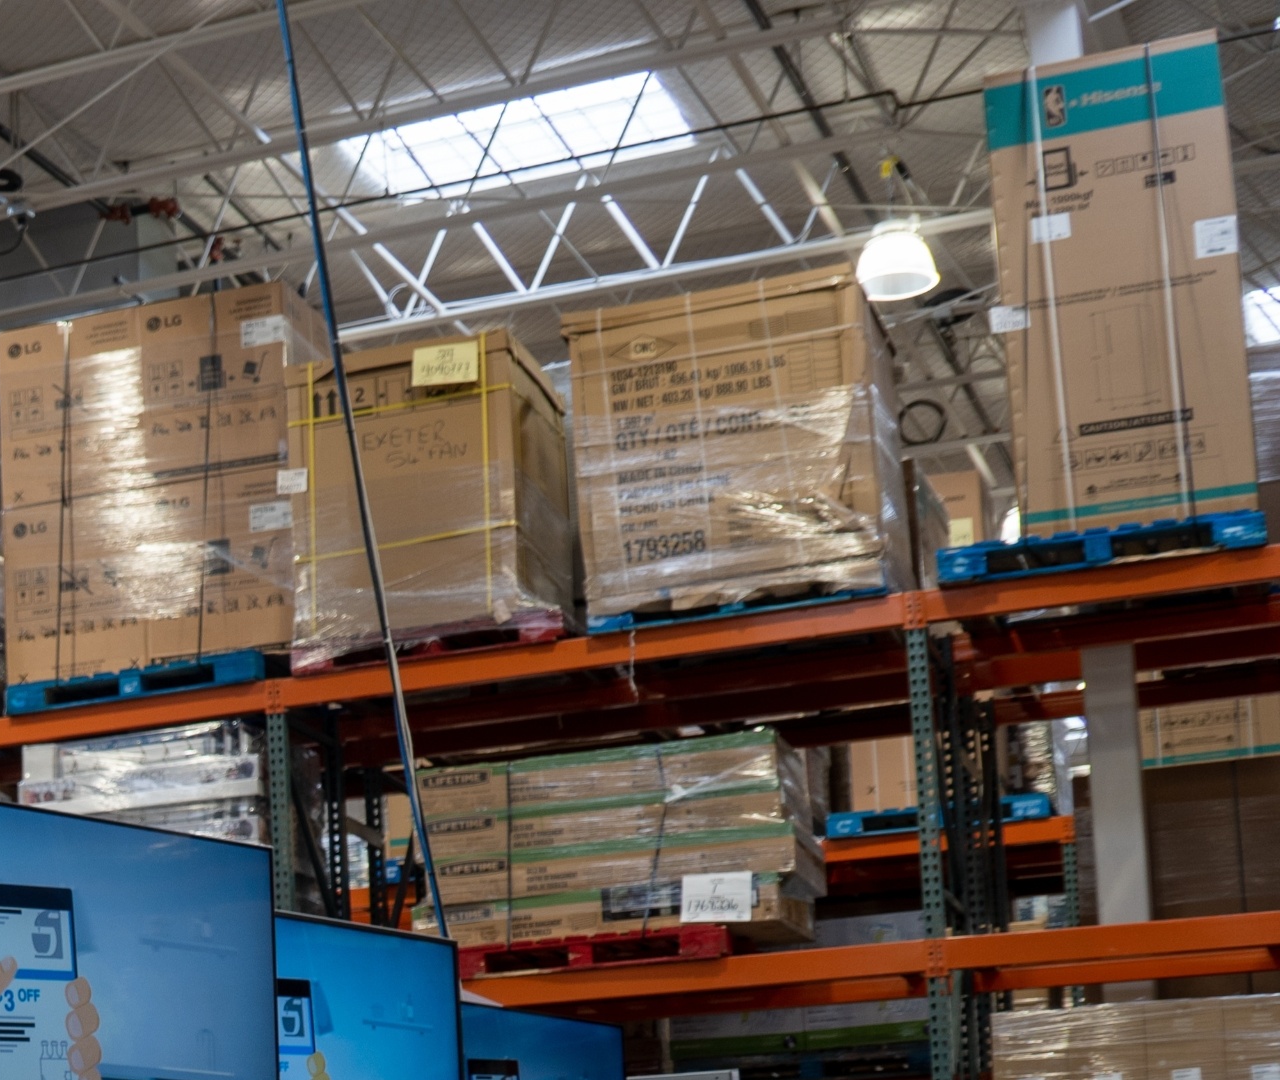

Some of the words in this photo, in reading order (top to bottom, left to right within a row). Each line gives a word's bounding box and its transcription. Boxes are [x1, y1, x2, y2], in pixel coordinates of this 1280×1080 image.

[164, 314, 182, 327] LG
[24, 342, 41, 354] LG
[363, 420, 446, 452] EXETER
[30, 522, 47, 535] LG
[623, 529, 707, 563] 1793258
[427, 773, 482, 787] LIFETIME
[445, 862, 499, 875] LIFETIME
[18, 988, 40, 1002] OFF
